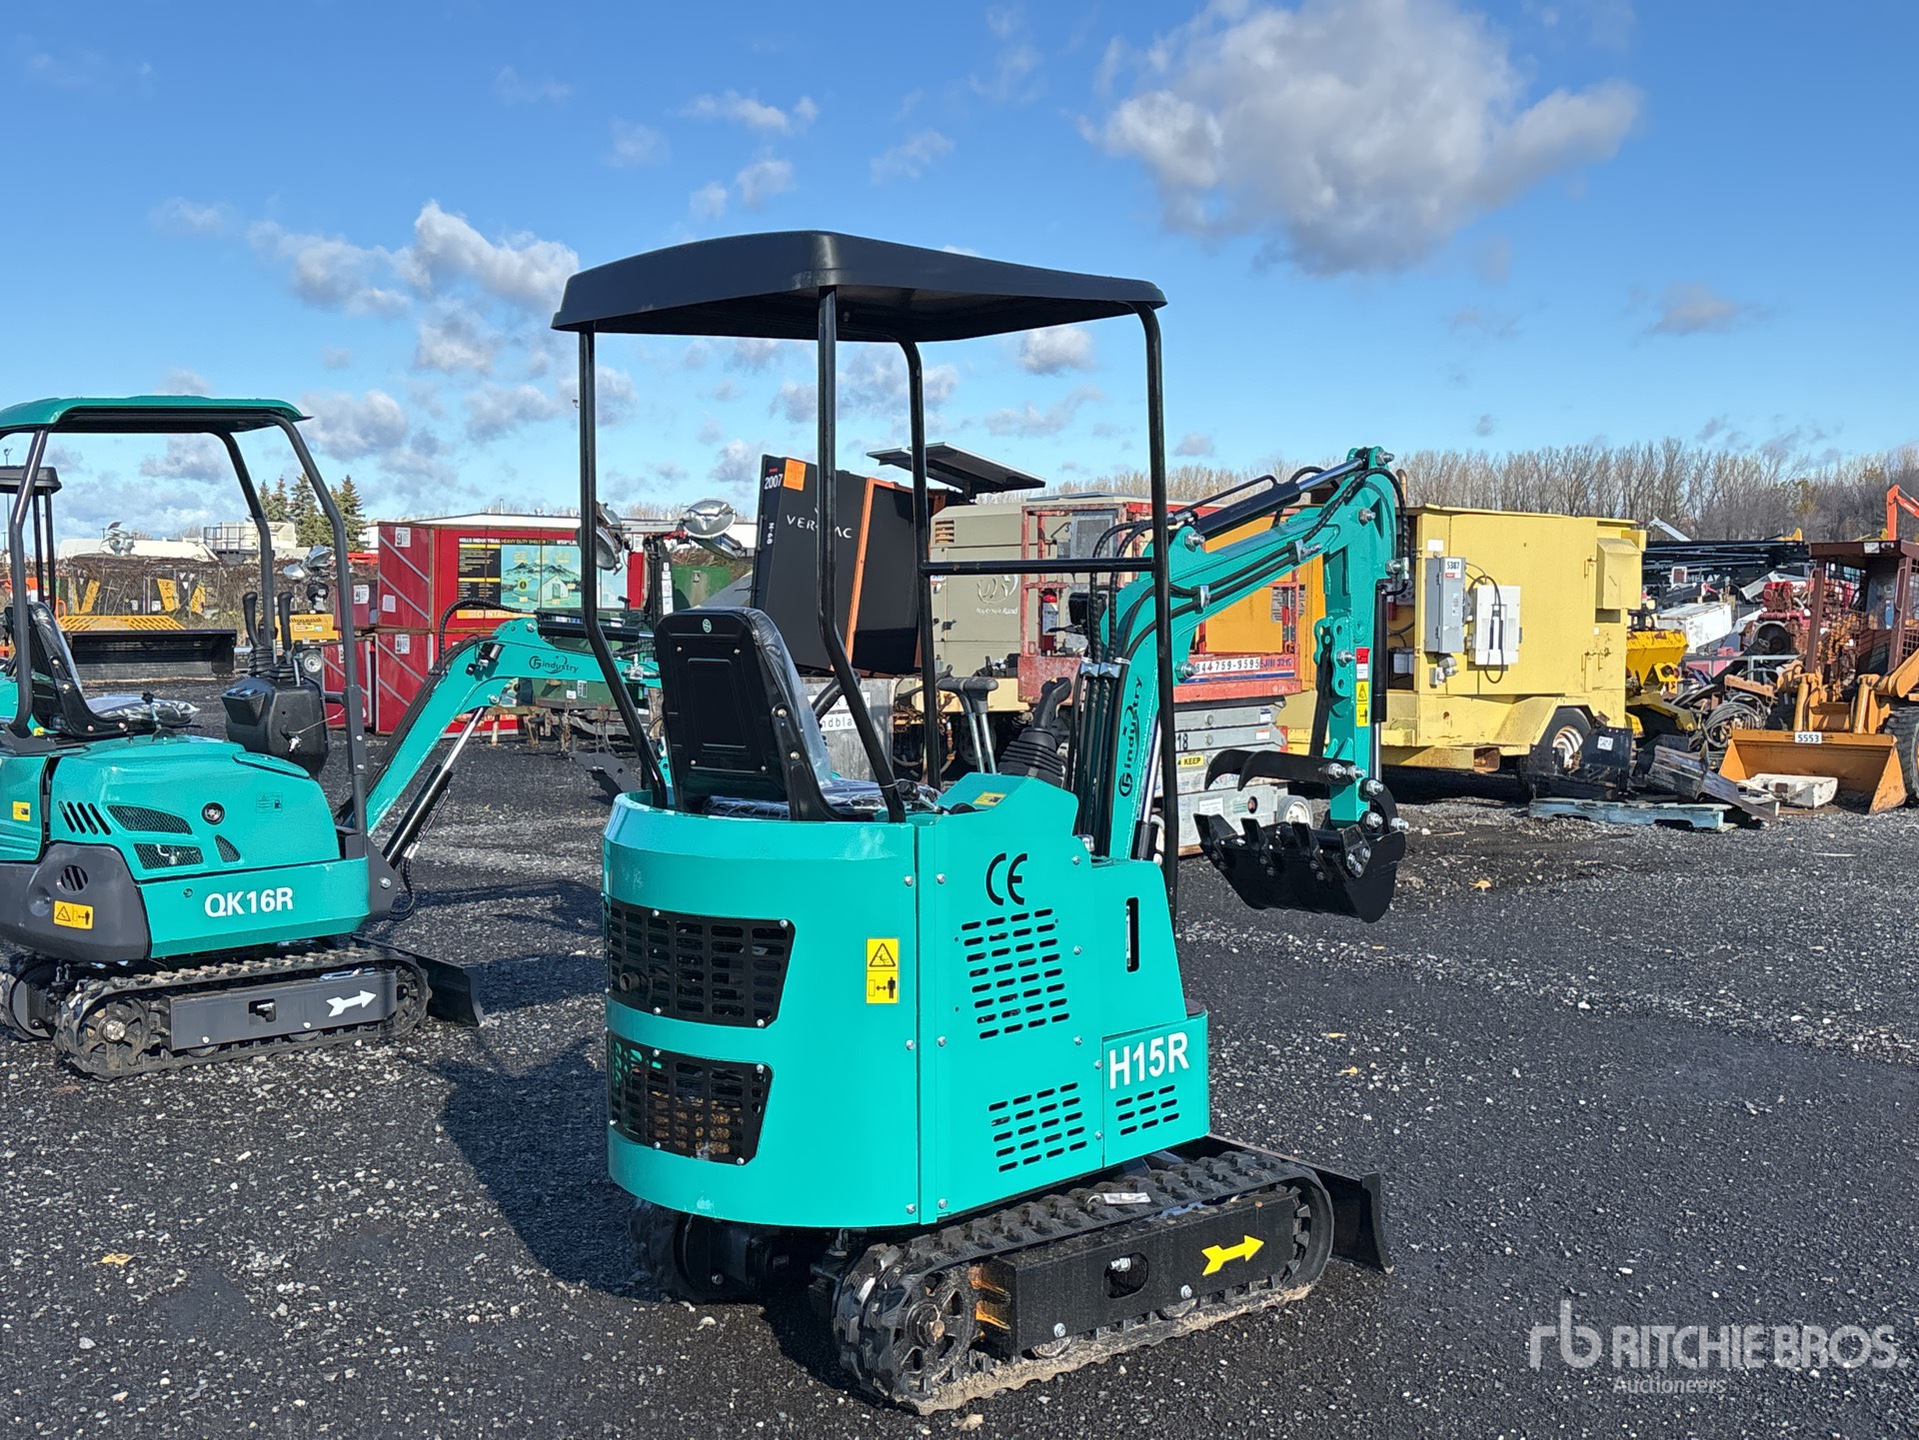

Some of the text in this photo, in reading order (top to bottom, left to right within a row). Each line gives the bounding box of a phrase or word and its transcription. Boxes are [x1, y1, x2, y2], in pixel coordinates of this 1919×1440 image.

[764, 474, 783, 489] 2007
[786, 514, 853, 539] VER-AC
[1797, 733, 1820, 743] 5553
[1183, 756, 1202, 767] KEEP
[204, 887, 294, 917] QK16R
[1109, 1031, 1190, 1090] H15R
